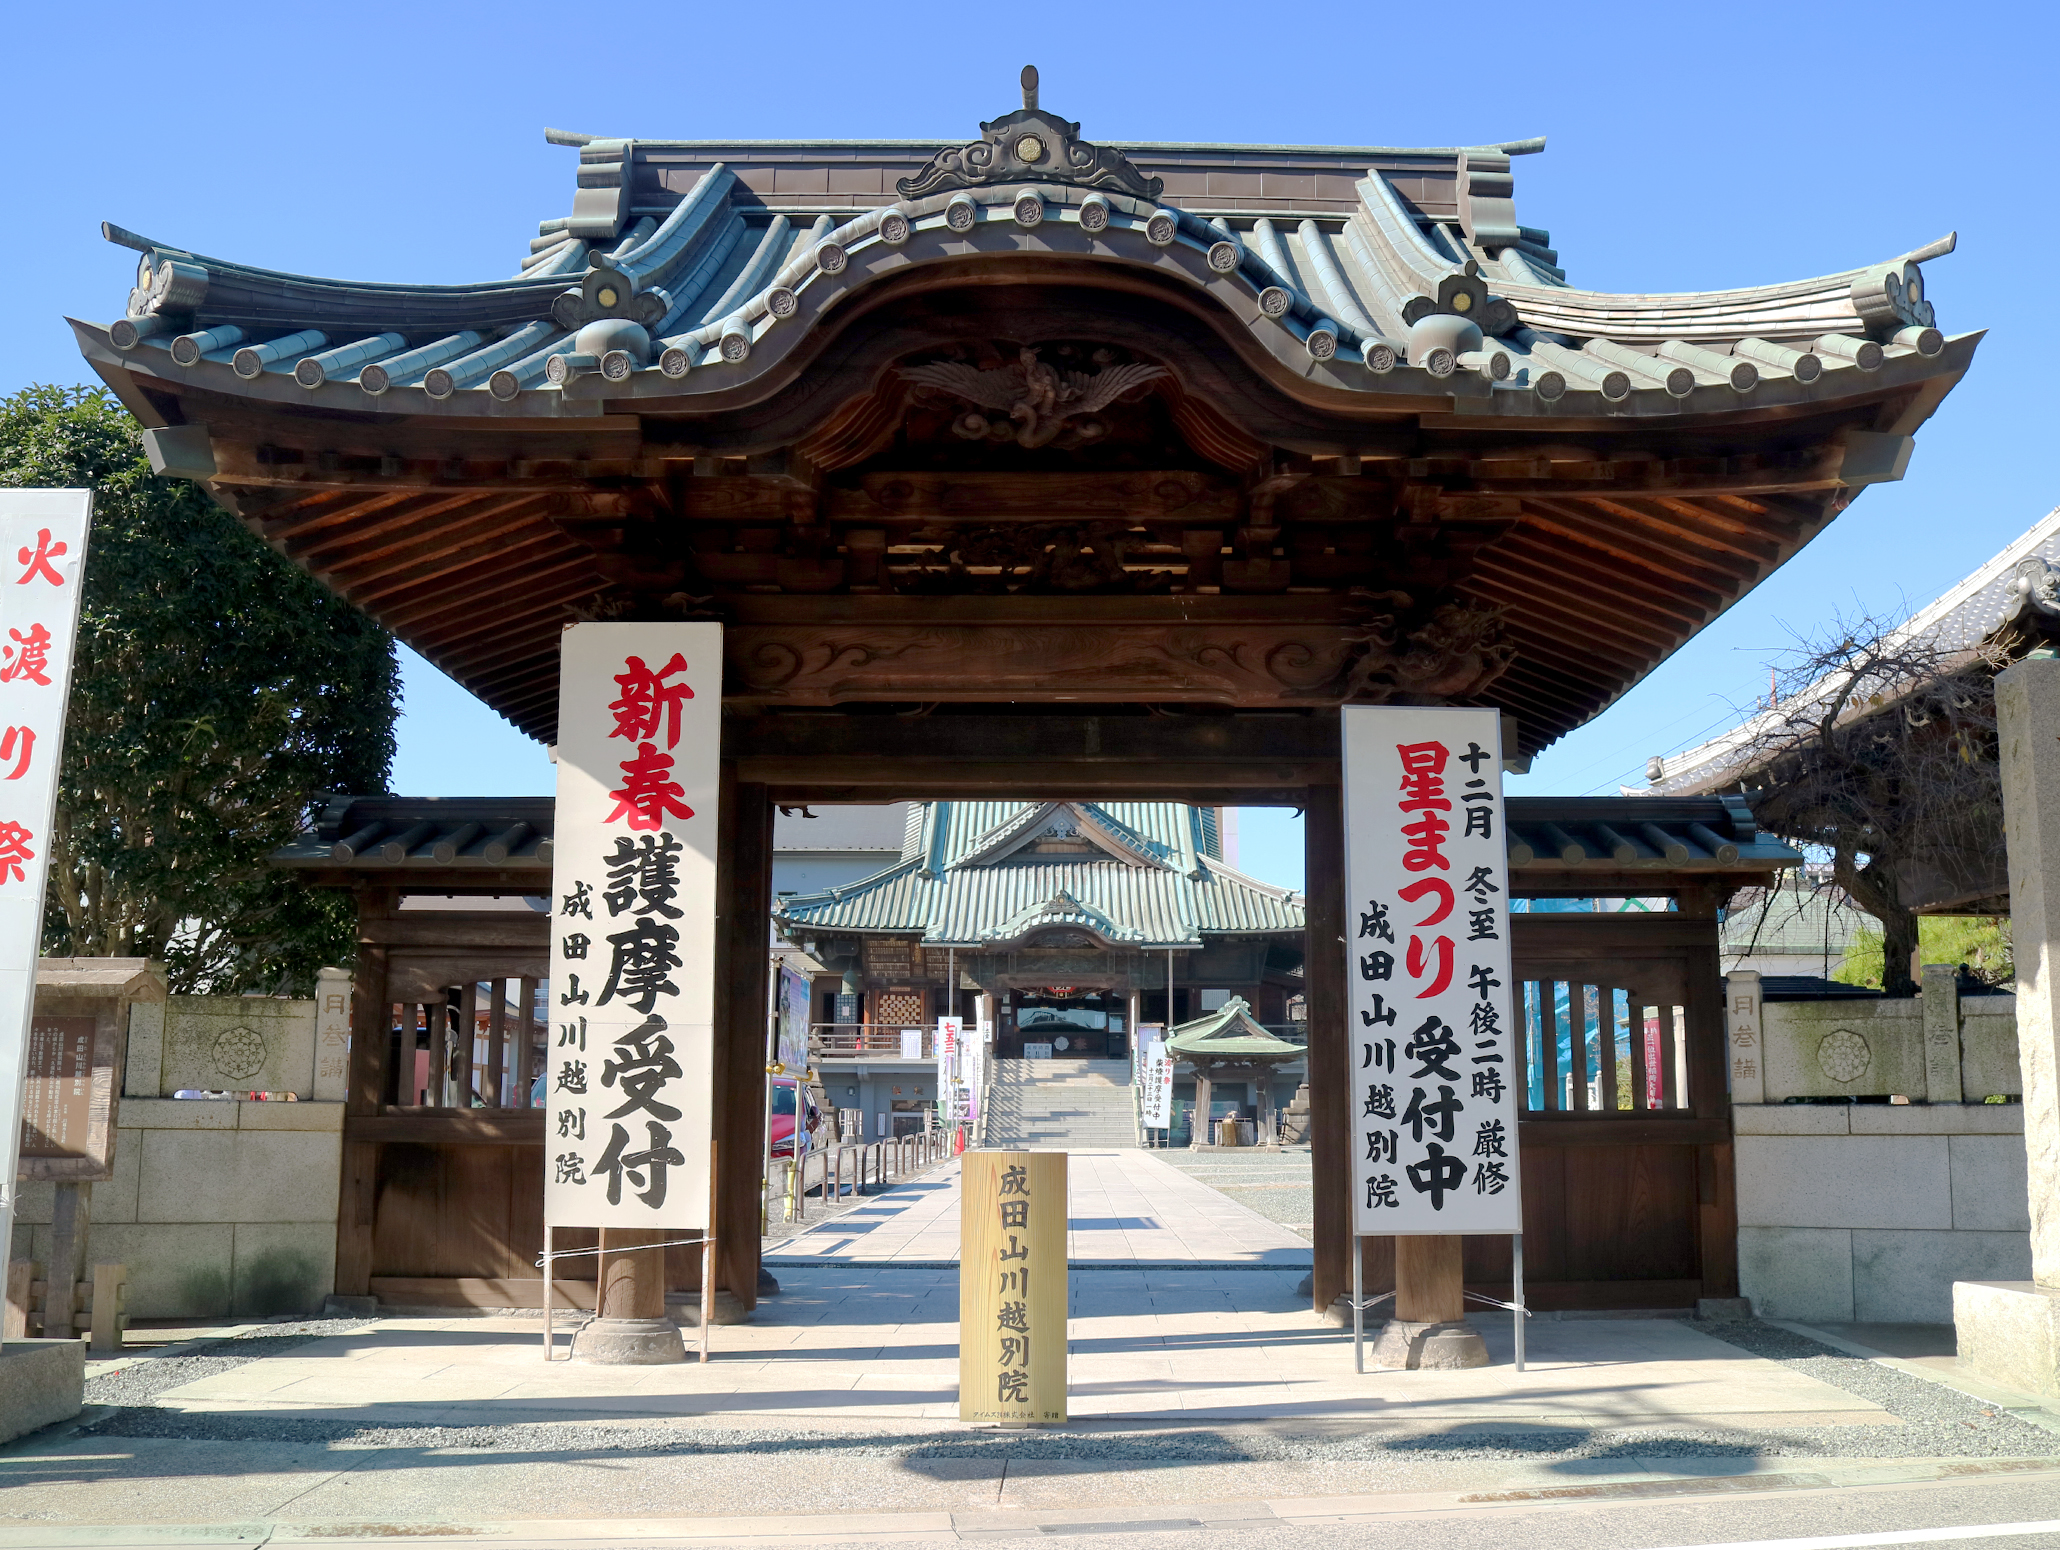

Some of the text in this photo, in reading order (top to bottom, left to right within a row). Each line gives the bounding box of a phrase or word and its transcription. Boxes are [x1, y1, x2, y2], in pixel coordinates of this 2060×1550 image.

[0, 527, 68, 886] 火渡り祭
[73, 1036, 84, 1096] 成田山川越別院
[554, 880, 595, 1187] 成田山川越別院
[591, 653, 695, 1208] 新春護摩受付
[944, 1022, 956, 1053] 七五三
[1359, 899, 1400, 1210] 成田山川越別院
[1396, 740, 1467, 1212] 星まつり受付中
[1457, 742, 1510, 1197] 十二月 冬至 午後二時 厳修
[997, 1164, 1031, 1402] 成田山川越別院
